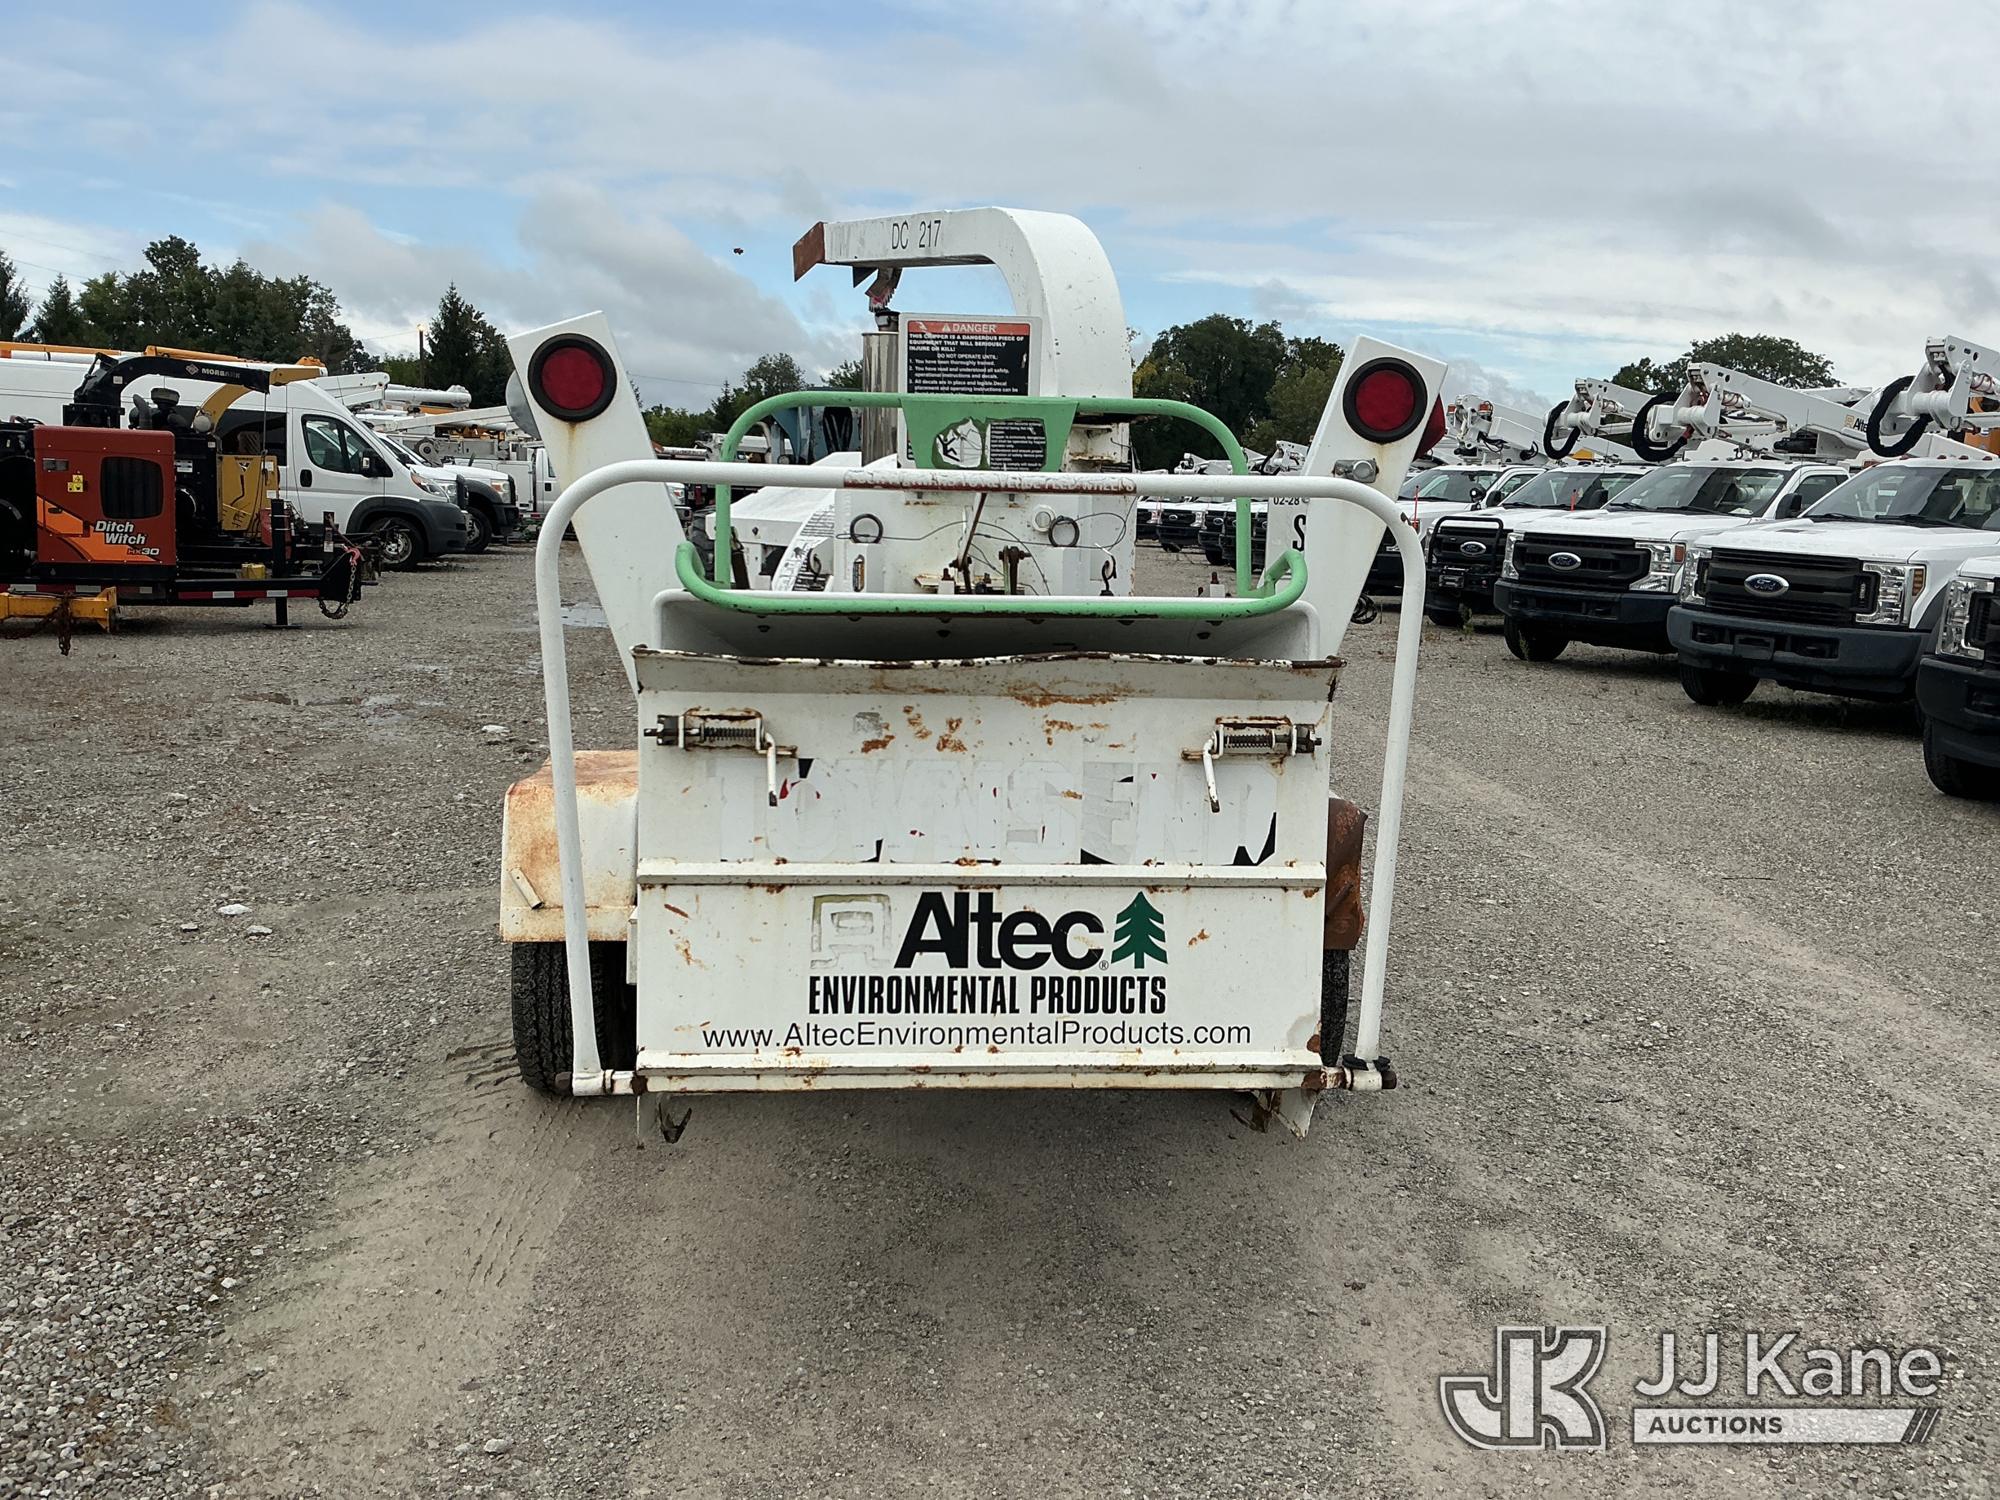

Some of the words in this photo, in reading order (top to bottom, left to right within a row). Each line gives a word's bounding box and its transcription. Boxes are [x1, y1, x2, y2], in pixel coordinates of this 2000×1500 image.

[892, 220, 909, 250] DC
[919, 219, 942, 248] 217
[952, 323, 997, 333] DANGER
[1853, 417, 1869, 432] Alte
[95, 520, 134, 533] Ditch
[105, 533, 146, 545] Witch
[894, 891, 1106, 972] Altec
[808, 975, 1020, 1015] ENVIRONMENTAL
[1030, 975, 1168, 1016] PRODUCTS
[702, 1020, 1252, 1050] www.AltecEnvironmentalProducts.com
